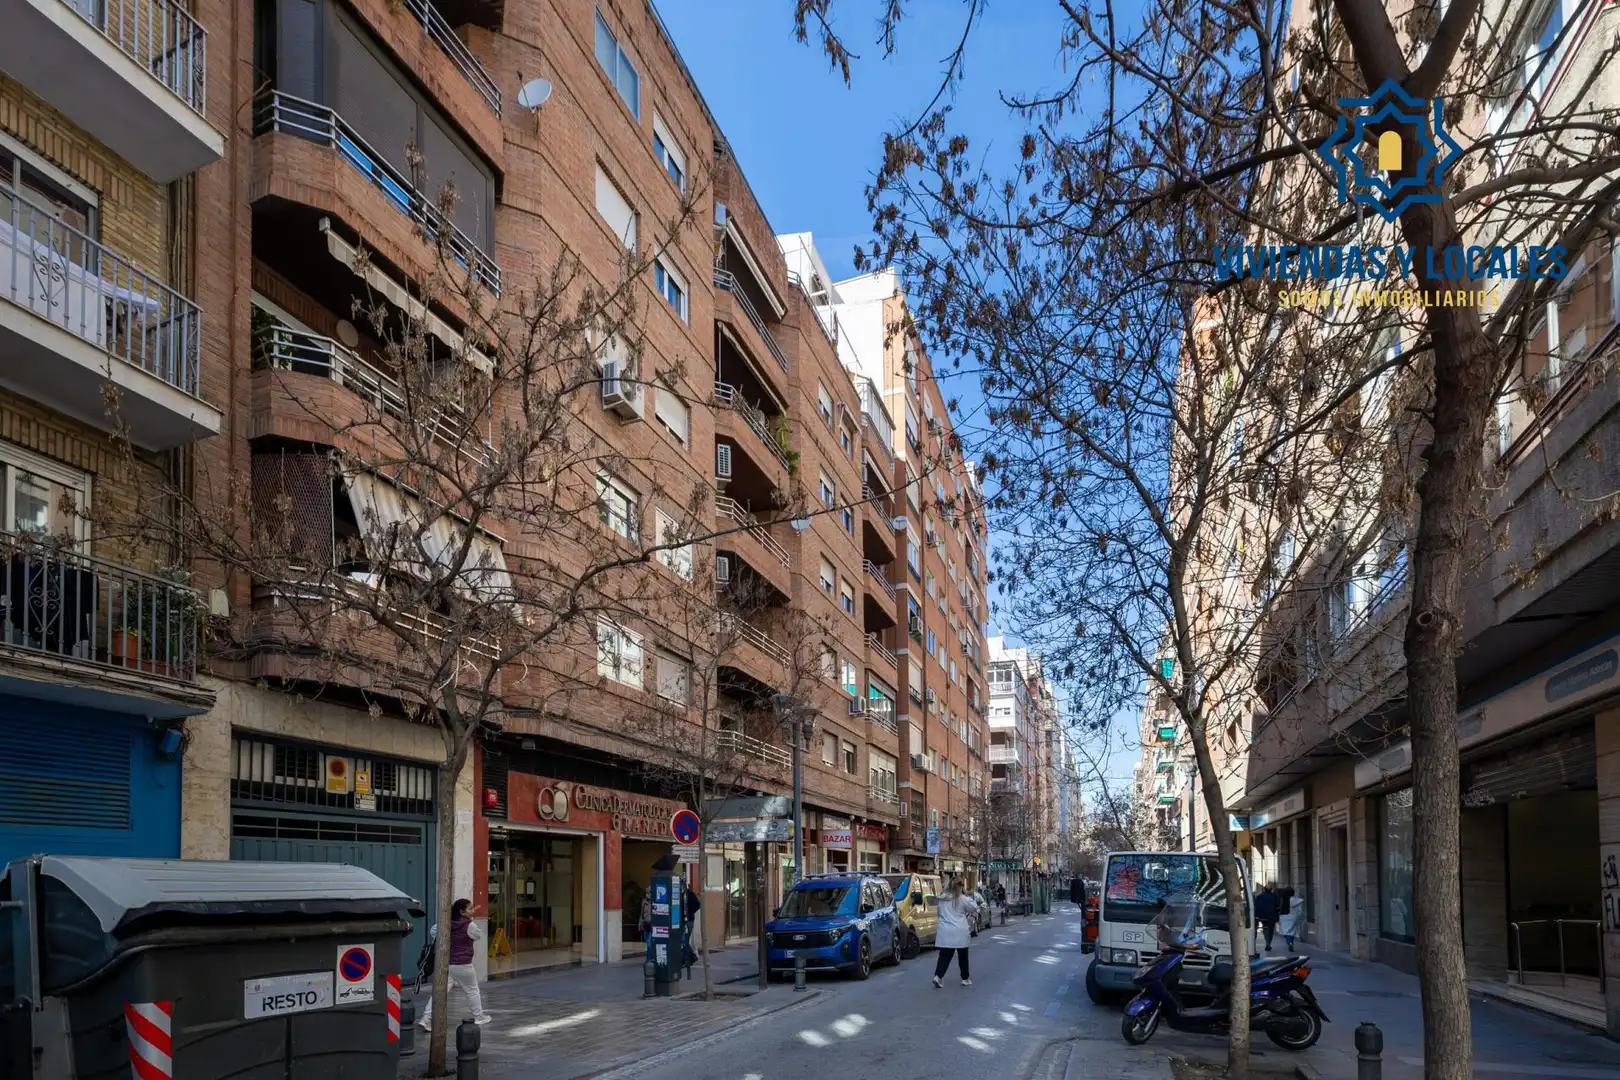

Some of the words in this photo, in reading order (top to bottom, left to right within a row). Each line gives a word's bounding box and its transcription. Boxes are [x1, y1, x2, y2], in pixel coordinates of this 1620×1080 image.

[823, 835, 852, 843] BAZAR
[1125, 932, 1142, 941] SP
[262, 991, 318, 1012] RESTO
